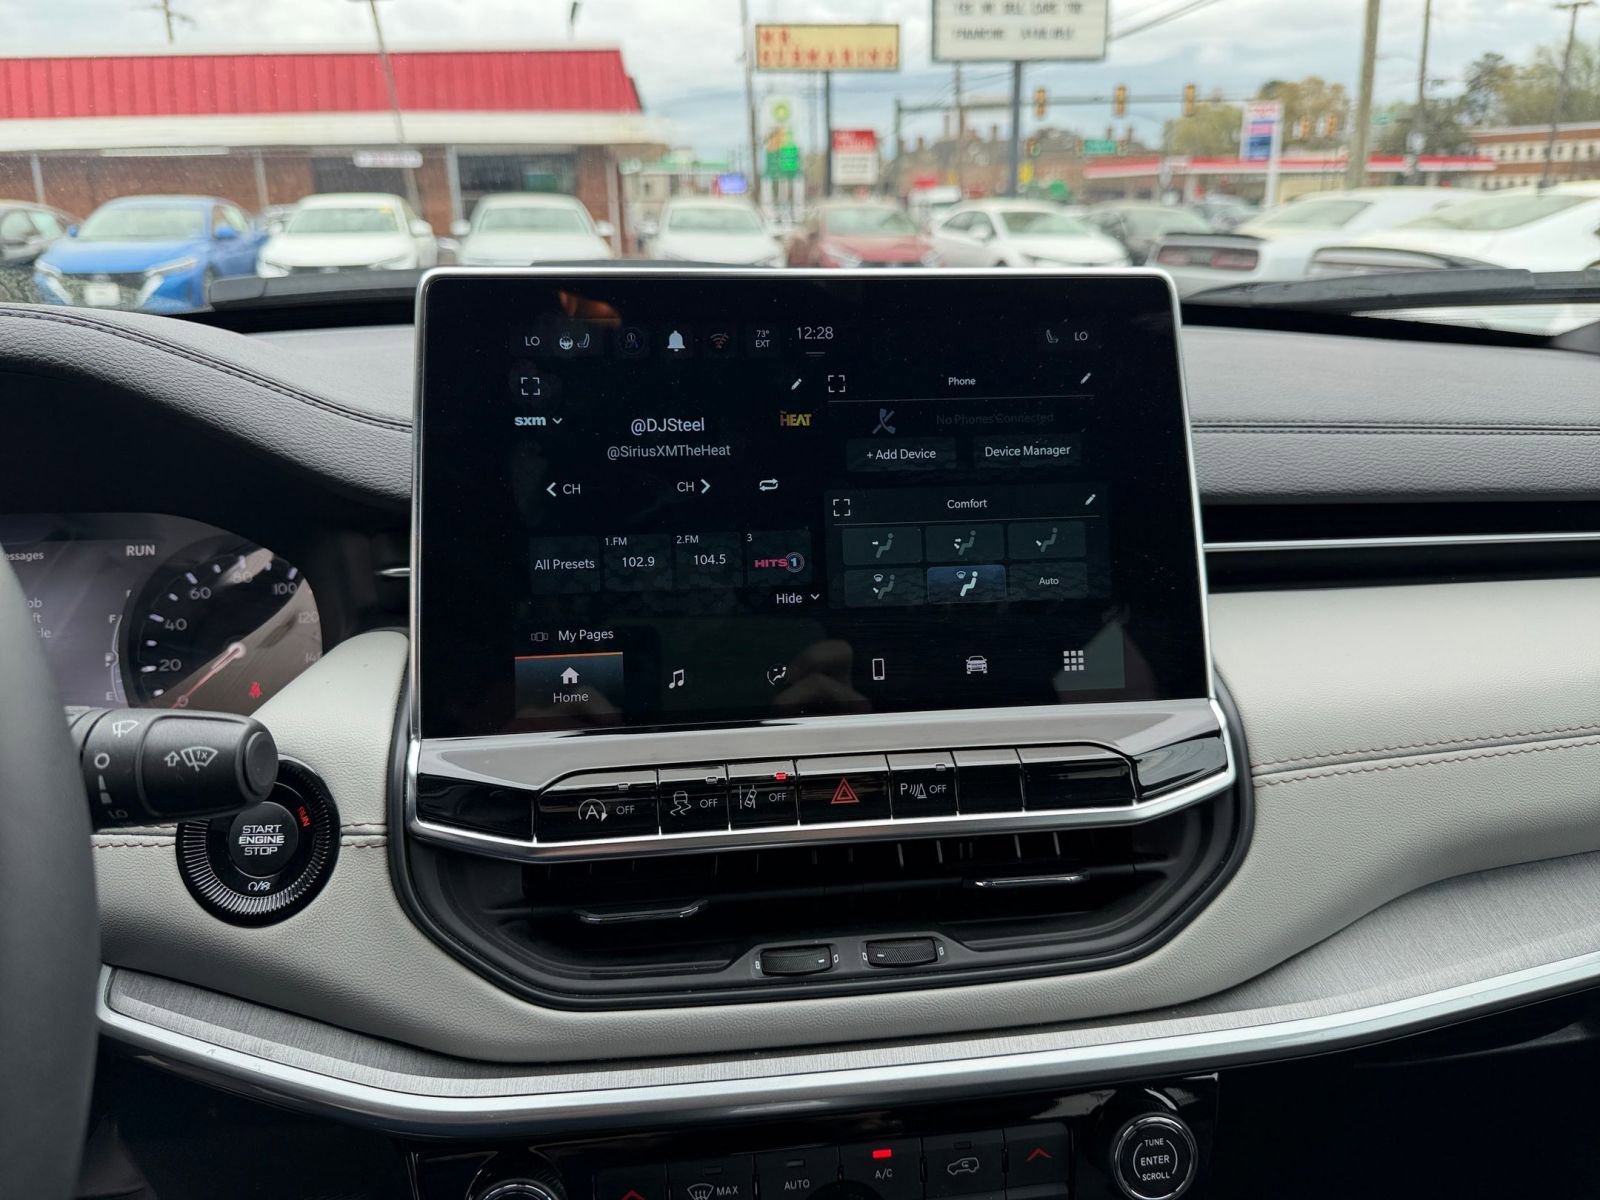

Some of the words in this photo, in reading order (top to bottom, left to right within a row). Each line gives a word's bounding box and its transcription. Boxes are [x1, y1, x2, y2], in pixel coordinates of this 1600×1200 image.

[797, 326, 834, 340] 12:28
[1074, 331, 1088, 342] LO
[525, 335, 540, 347] LO
[755, 339, 771, 348] EXT
[948, 376, 976, 387] Phone
[514, 415, 546, 427] sxm
[780, 413, 812, 427] HEAT
[936, 415, 952, 425] No
[631, 417, 705, 436] @DJSteel
[607, 444, 732, 461] @SiriusXMTheHeat
[875, 448, 898, 461] Add
[900, 447, 937, 460] Device
[984, 445, 1021, 458] Device
[1023, 444, 1072, 459] Manager
[562, 483, 582, 496] CH
[676, 481, 695, 493] CH
[946, 498, 988, 510] Comfort
[604, 536, 628, 547] 1.FM
[676, 534, 700, 545] 2.FM
[746, 533, 753, 542] 3
[126, 544, 156, 557] RUN
[534, 558, 550, 571] All
[552, 557, 596, 570] Presets
[621, 556, 656, 569] 102.9
[693, 553, 727, 566] 104.5
[1039, 576, 1060, 586] Auto
[190, 586, 212, 599] 60
[273, 582, 298, 595] 100
[776, 592, 803, 604] Hide
[109, 614, 117, 624] F
[165, 618, 187, 631] 40
[558, 630, 577, 643] My
[579, 629, 614, 643] Pages
[159, 658, 182, 671] 20
[553, 691, 589, 704] Home
[900, 783, 908, 795] P
[929, 784, 947, 794] OFF
[699, 798, 718, 808] OFF
[768, 792, 787, 802] OFF
[616, 804, 635, 815] OFF
[298, 806, 311, 828] RUN
[242, 825, 282, 834] START
[238, 835, 285, 845] ENGINE
[244, 846, 278, 856] STOP
[1144, 1138, 1165, 1148] TUNE
[1140, 1154, 1170, 1167] ENTER
[874, 1167, 893, 1180] A/C
[1141, 1171, 1171, 1182] SCROLL
[716, 1184, 739, 1197] MAX
[784, 1178, 811, 1192] AUTO
